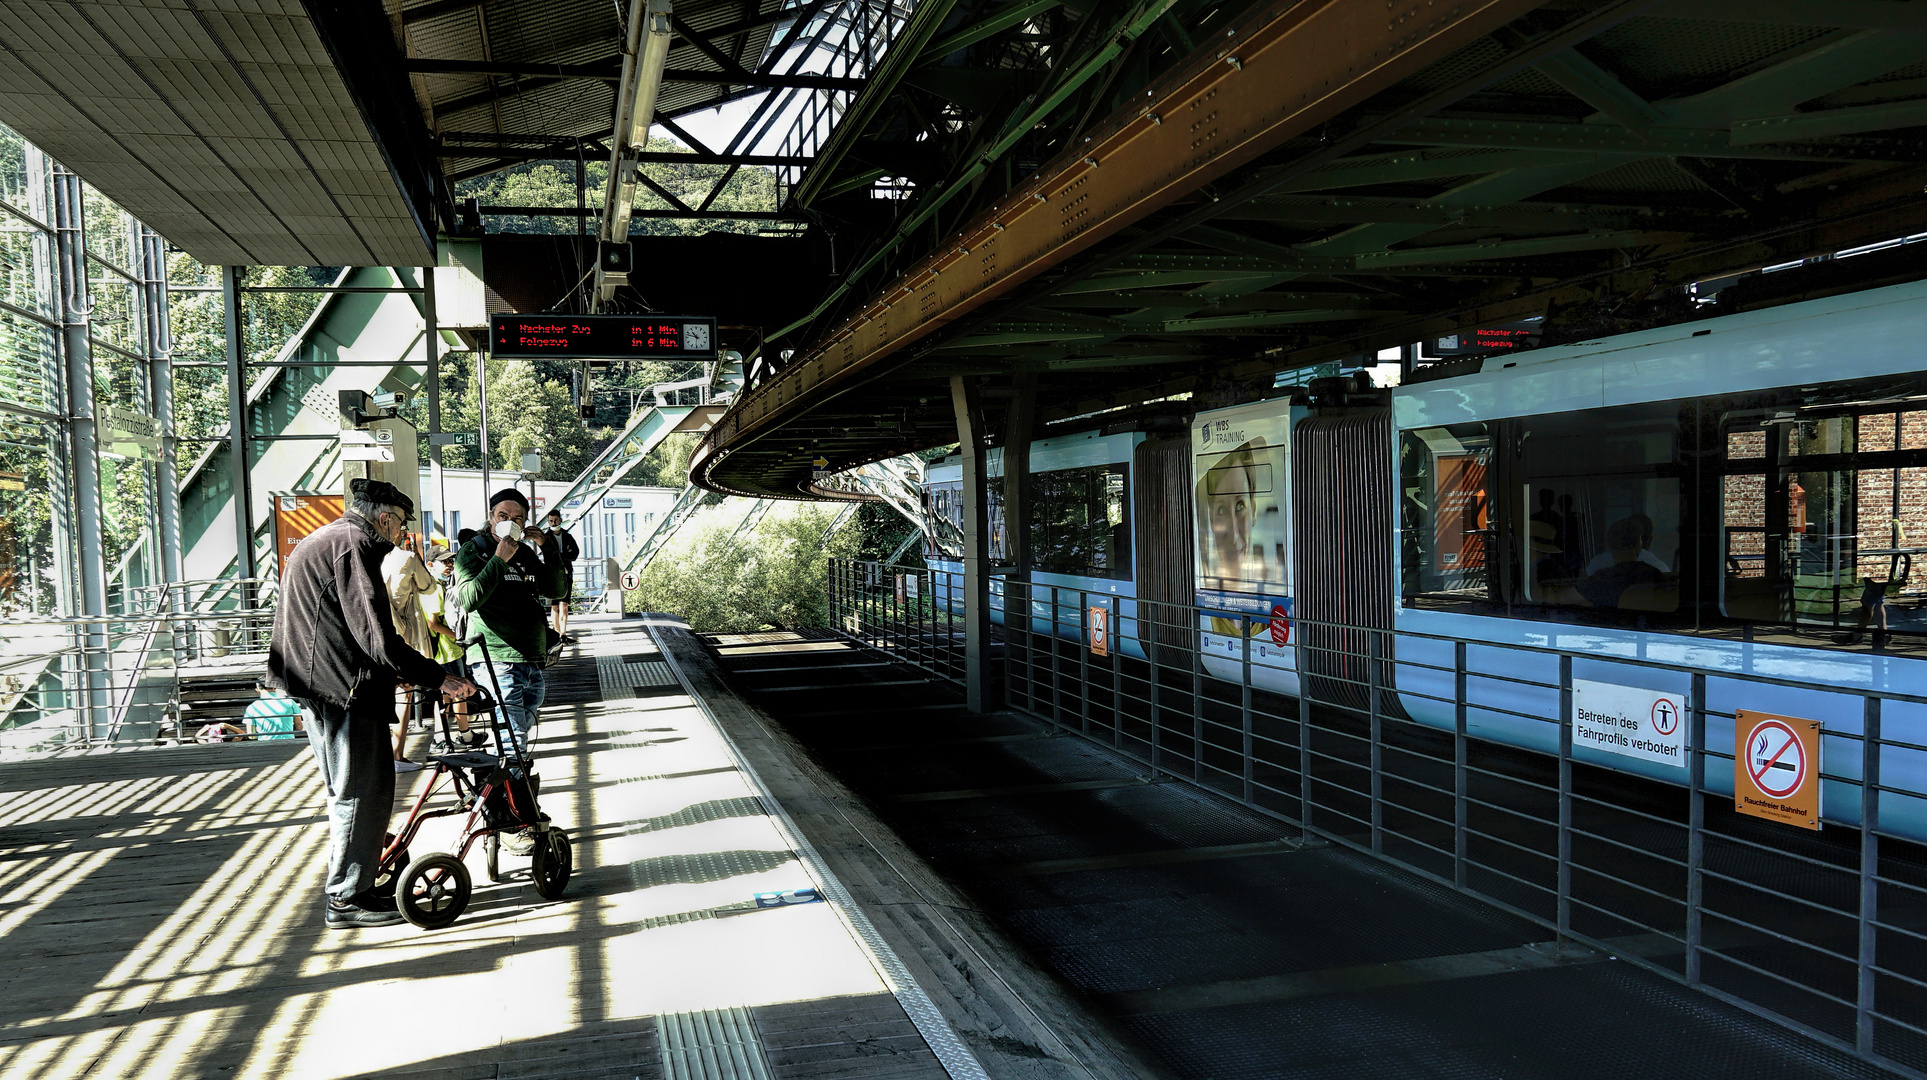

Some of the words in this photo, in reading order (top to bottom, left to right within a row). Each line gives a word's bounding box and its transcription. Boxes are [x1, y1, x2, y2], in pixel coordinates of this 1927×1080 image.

[519, 325, 567, 334] Nächster
[572, 325, 591, 335] Zug
[631, 325, 642, 334] in
[647, 326, 653, 334] 1
[519, 337, 568, 347] Folgezug
[631, 338, 642, 347] in
[647, 338, 654, 347] 6
[100, 407, 154, 438] Pestalozzistraße
[1216, 420, 1230, 432] WBS
[1216, 430, 1245, 444] TRAINING
[1578, 708, 1617, 726] Betreten
[1620, 716, 1638, 731] des
[1577, 725, 1629, 747] Fahrprofils
[1631, 739, 1677, 757] verboten
[1744, 796, 1779, 810] Rauchfreier
[1780, 804, 1808, 817] Bahnhof
